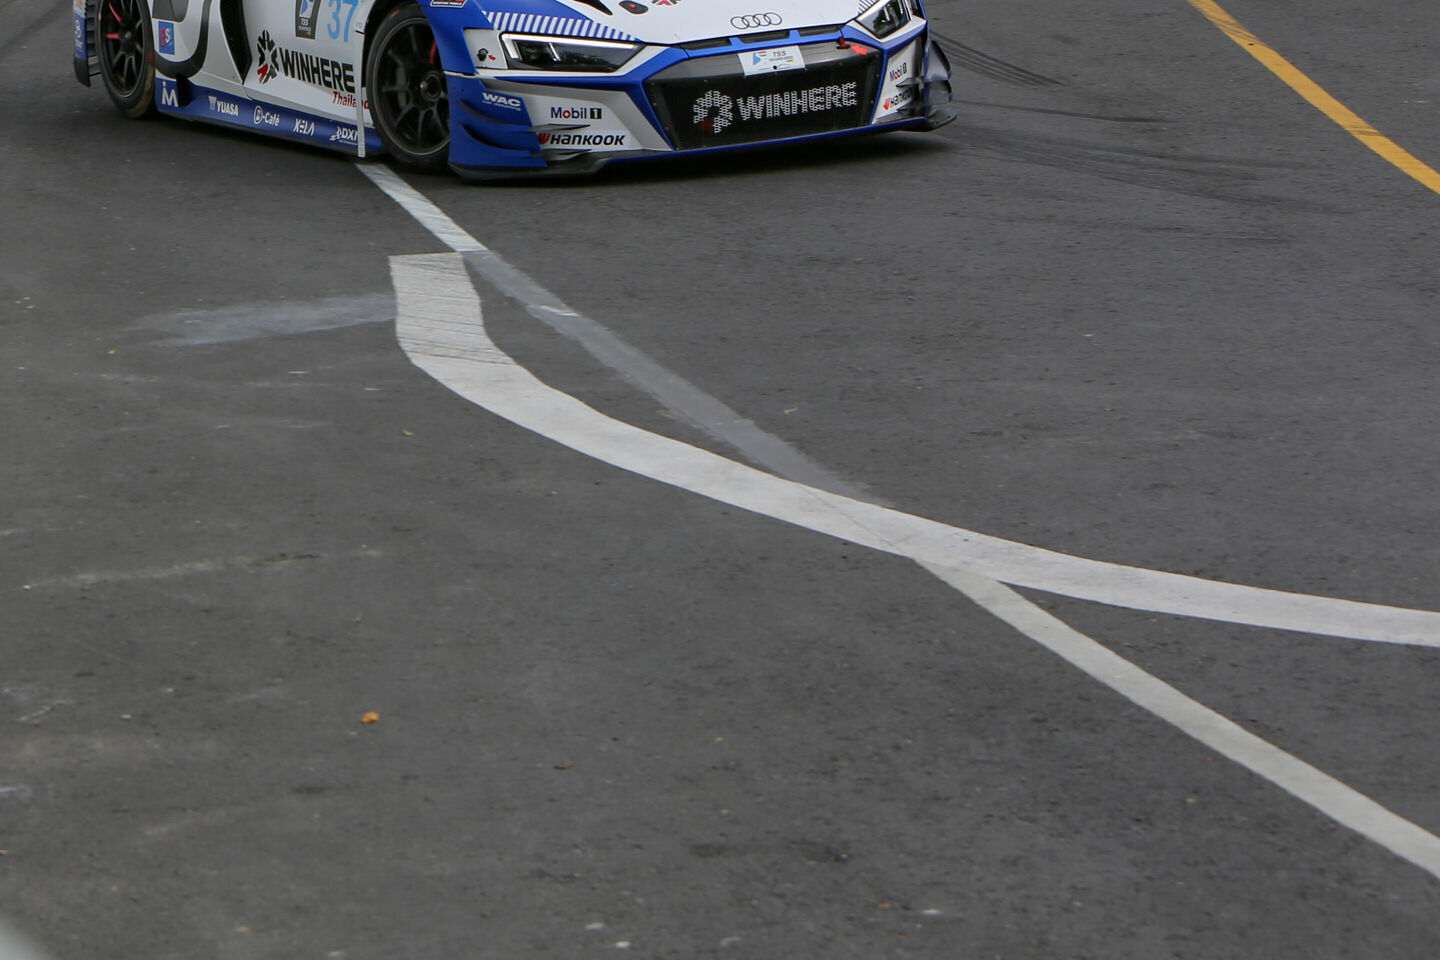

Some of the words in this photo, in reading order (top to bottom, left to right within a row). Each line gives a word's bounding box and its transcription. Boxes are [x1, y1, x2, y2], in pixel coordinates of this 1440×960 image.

[279, 47, 356, 94] WINHERE
[482, 92, 521, 107] WAC
[737, 82, 857, 120] WINHERE
[216, 100, 239, 117] YUASA
[550, 107, 587, 119] Mobil
[590, 108, 602, 119] 1
